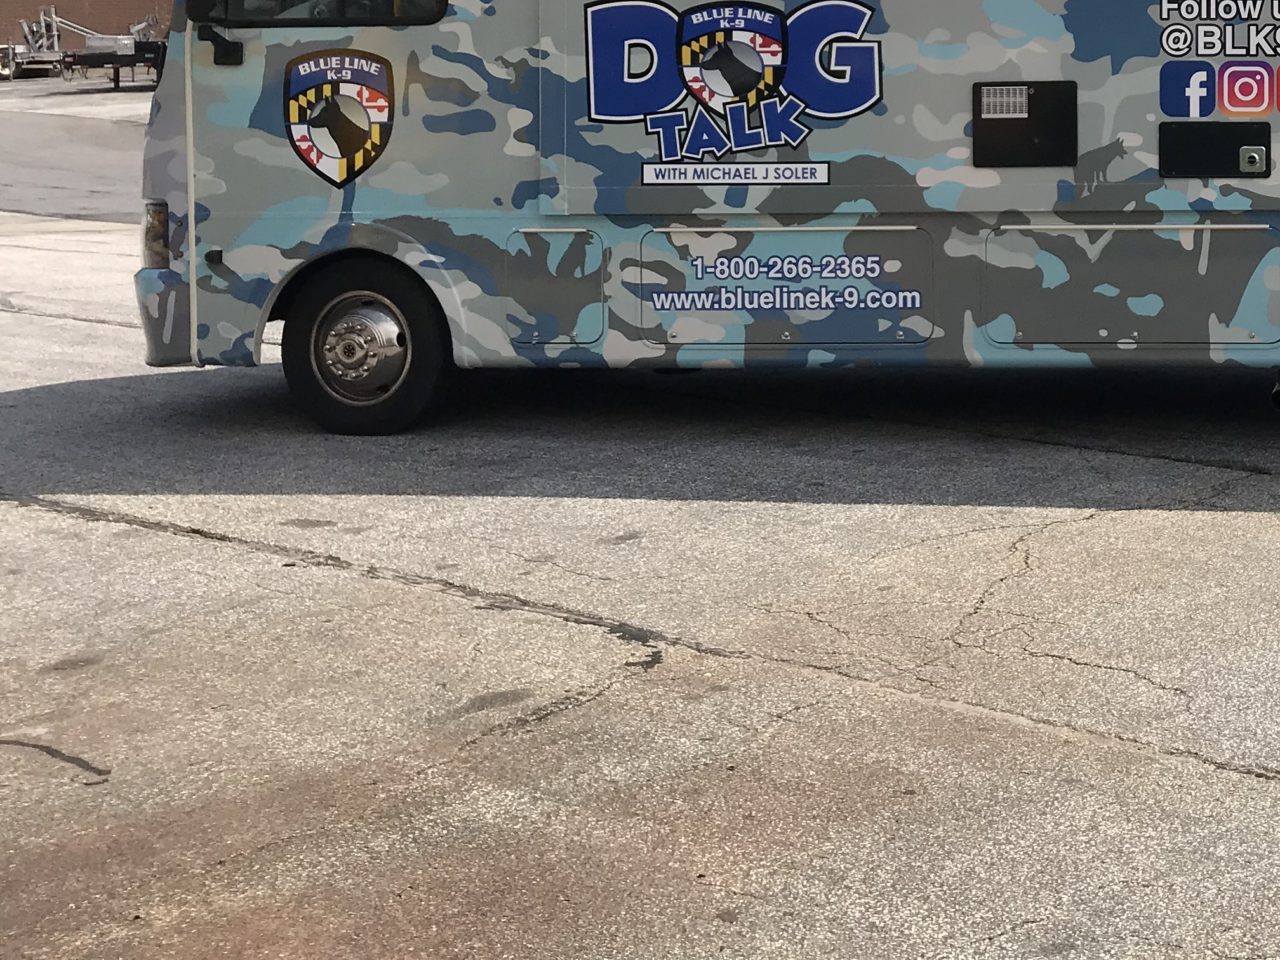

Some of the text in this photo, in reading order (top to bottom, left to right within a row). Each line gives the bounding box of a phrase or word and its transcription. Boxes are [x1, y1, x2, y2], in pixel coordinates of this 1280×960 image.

[691, 7, 775, 25] BLUE LINE
[720, 19, 745, 28] K-9
[298, 57, 381, 76] BLUE LINE
[326, 70, 352, 80] K-9
[644, 94, 813, 162] TALK
[653, 166, 818, 180] WITH MICHAEL J SOLER
[691, 256, 881, 279] 1-800-266-2365
[652, 288, 921, 310] www.bluelinek-9.com
